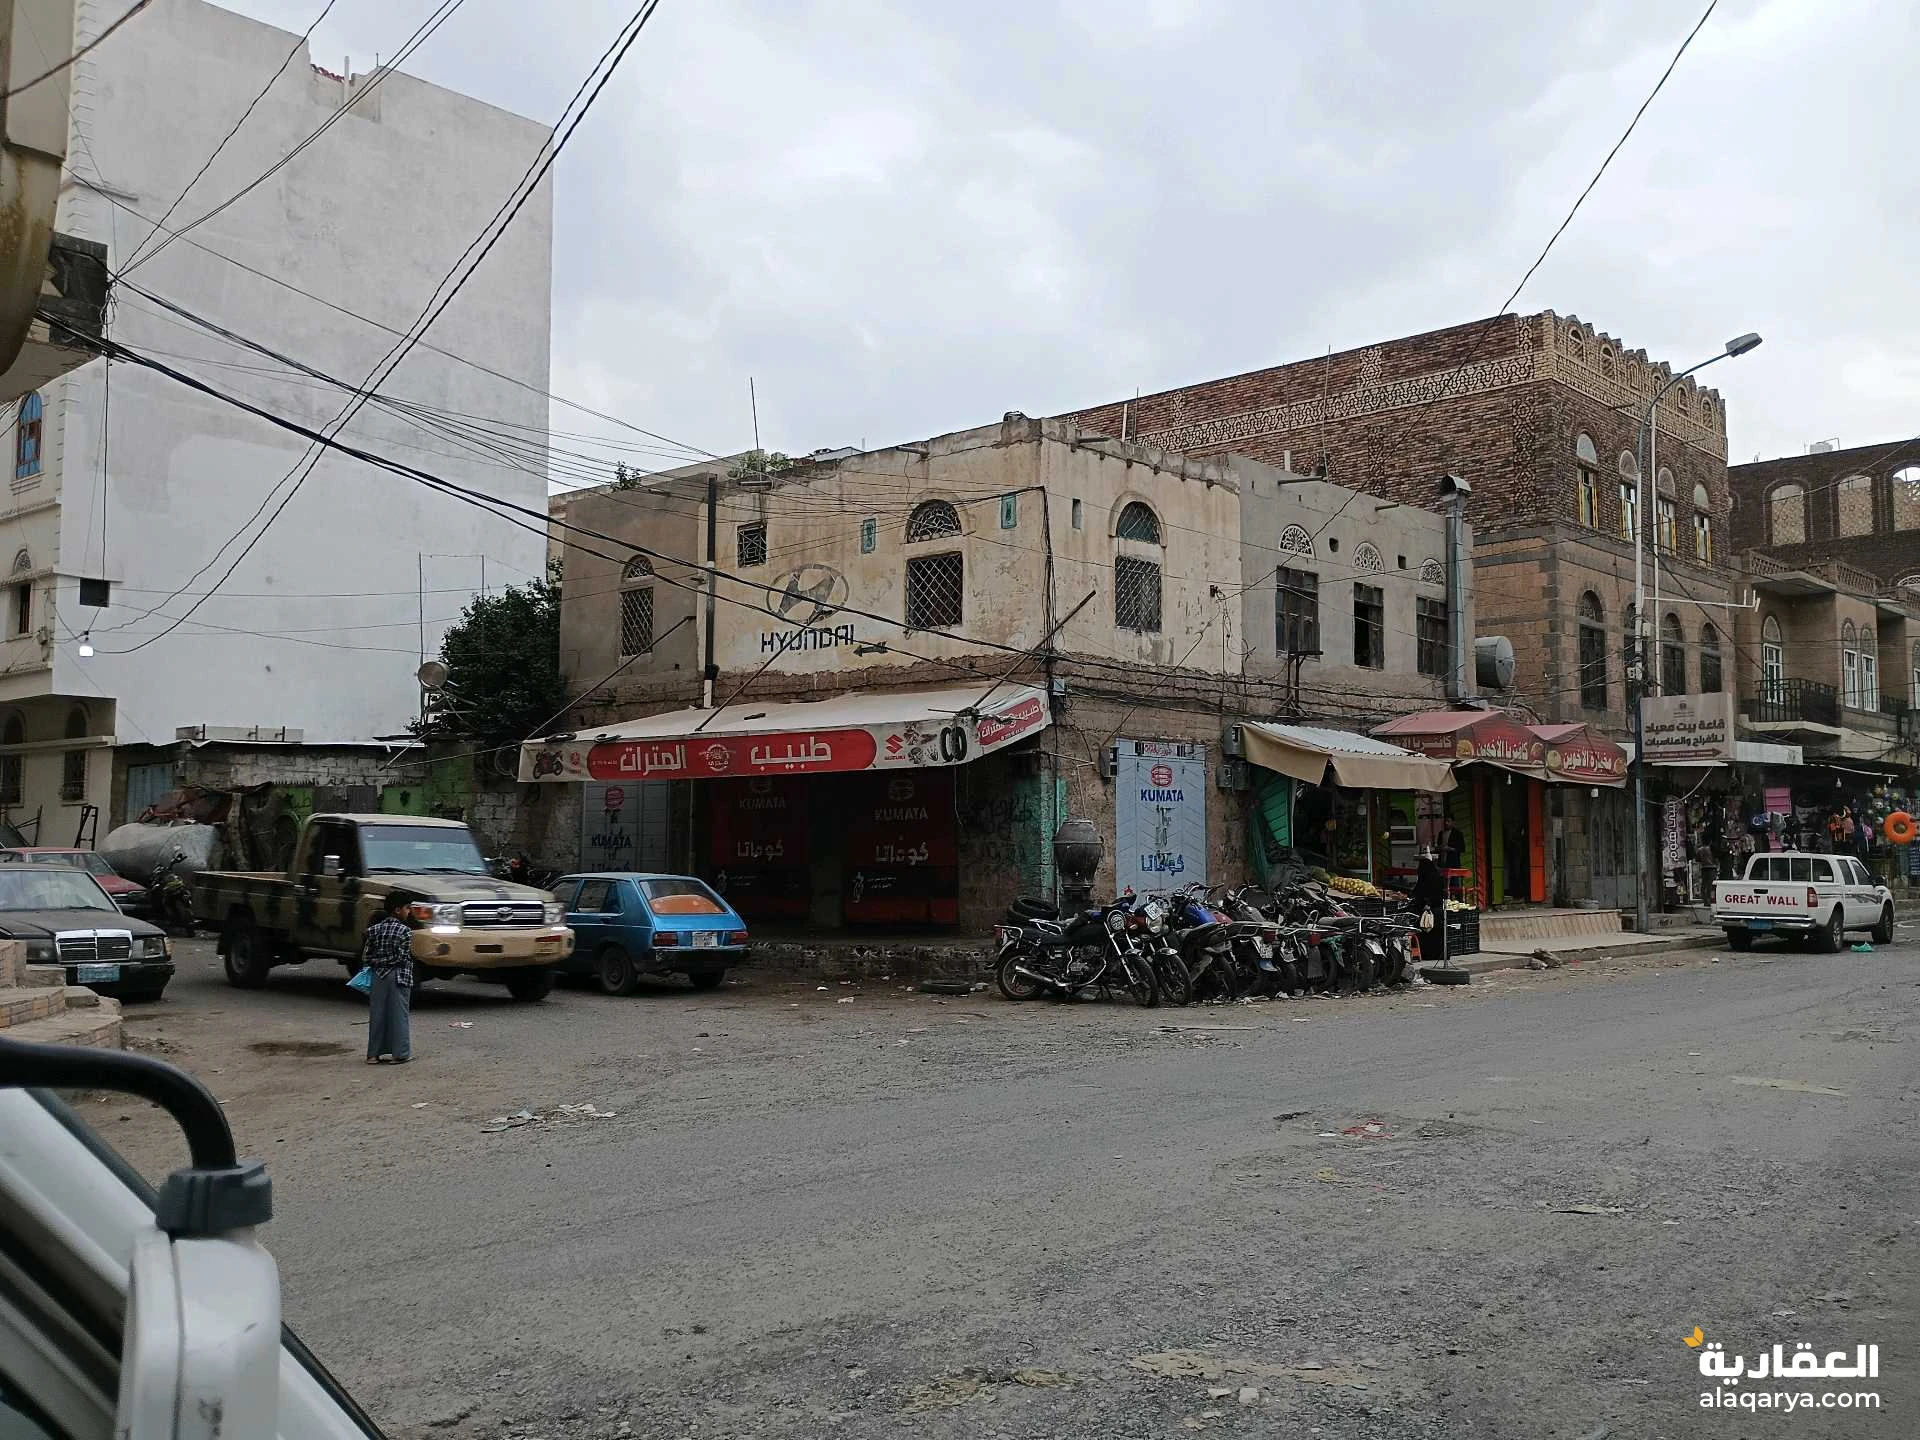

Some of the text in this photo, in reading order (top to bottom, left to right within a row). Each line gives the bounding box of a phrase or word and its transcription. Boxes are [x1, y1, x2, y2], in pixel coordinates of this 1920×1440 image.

[761, 624, 854, 653] HYUNDAI
[1676, 720, 1697, 733] بيت
[1698, 719, 1725, 730] قاعة
[1645, 736, 1691, 747] والمناسبات
[619, 744, 687, 776] المترات
[751, 736, 832, 772] طبيب
[1140, 789, 1184, 802] KUMATA
[873, 807, 929, 822] KUMATA
[1724, 894, 1799, 906] GREAT WALL
